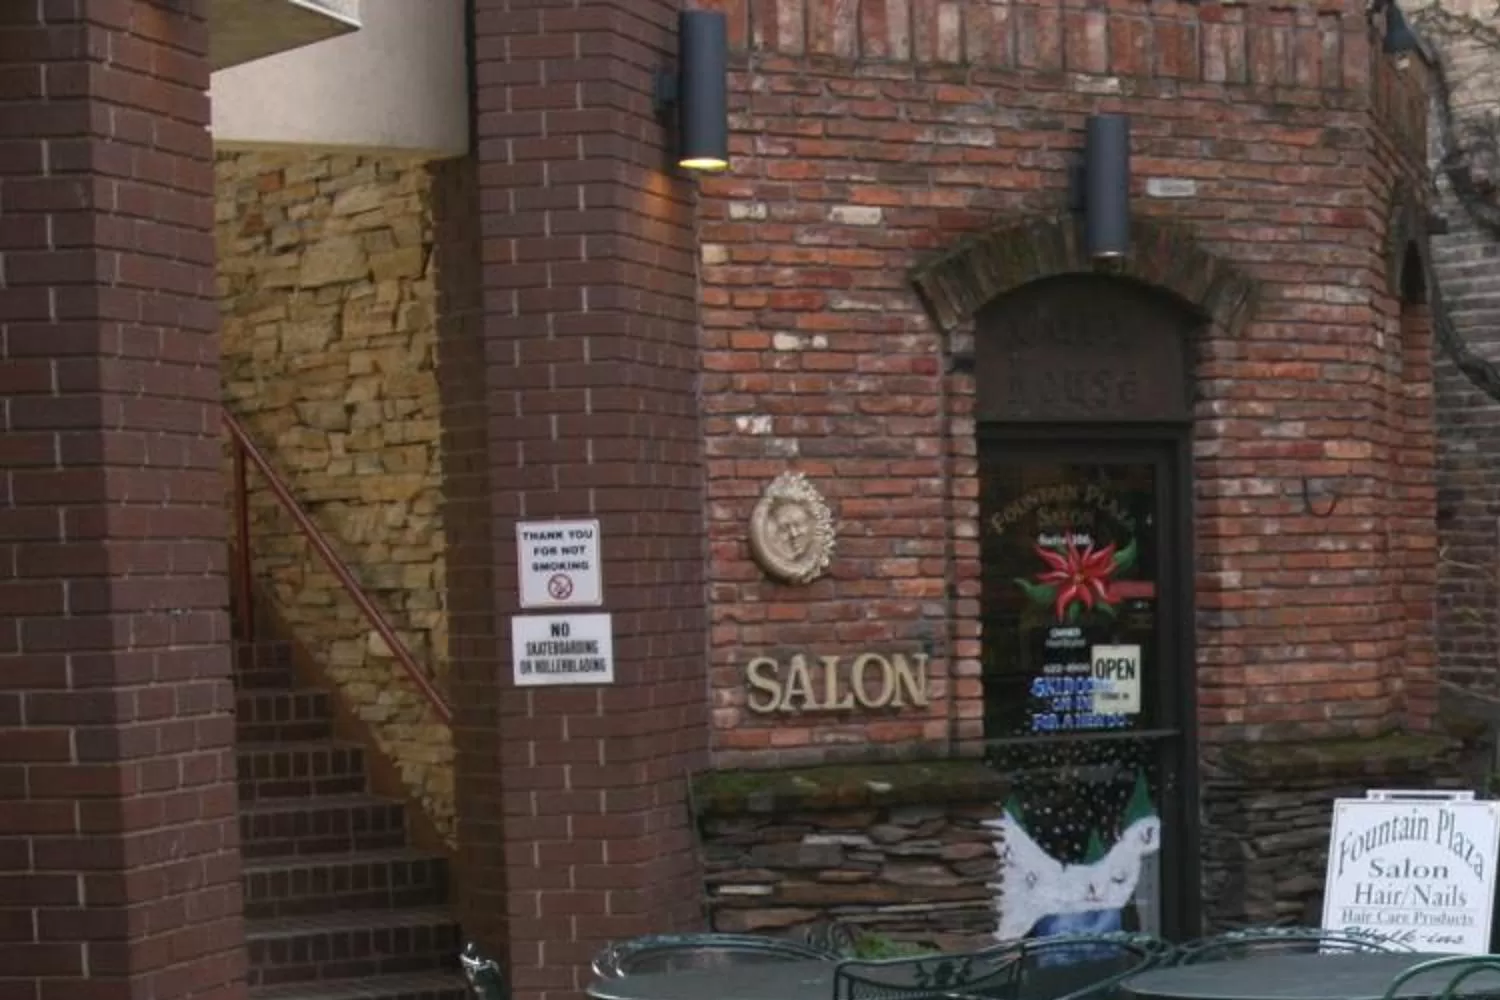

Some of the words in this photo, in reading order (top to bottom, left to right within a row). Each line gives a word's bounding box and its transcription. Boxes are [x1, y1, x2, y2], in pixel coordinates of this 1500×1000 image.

[522, 530, 563, 541] THANK
[568, 529, 593, 540] YOU
[533, 546, 557, 556] FOR
[561, 545, 586, 555] NOT
[532, 560, 590, 571] SMOKING
[550, 623, 570, 637] NO
[525, 640, 599, 657] SKATEBOARDING
[519, 659, 532, 675] OR
[535, 657, 607, 674] ROLLERBLADING
[1095, 658, 1135, 680] OPEN
[747, 652, 929, 713] SALON
[1338, 808, 1429, 880] Fountain
[1436, 808, 1485, 883] Plaza
[1367, 856, 1449, 880] Salon
[1353, 882, 1468, 908] Hair/Nails
[1341, 908, 1372, 924] Hair
[1376, 909, 1409, 925] Care
[1413, 910, 1475, 926] Products
